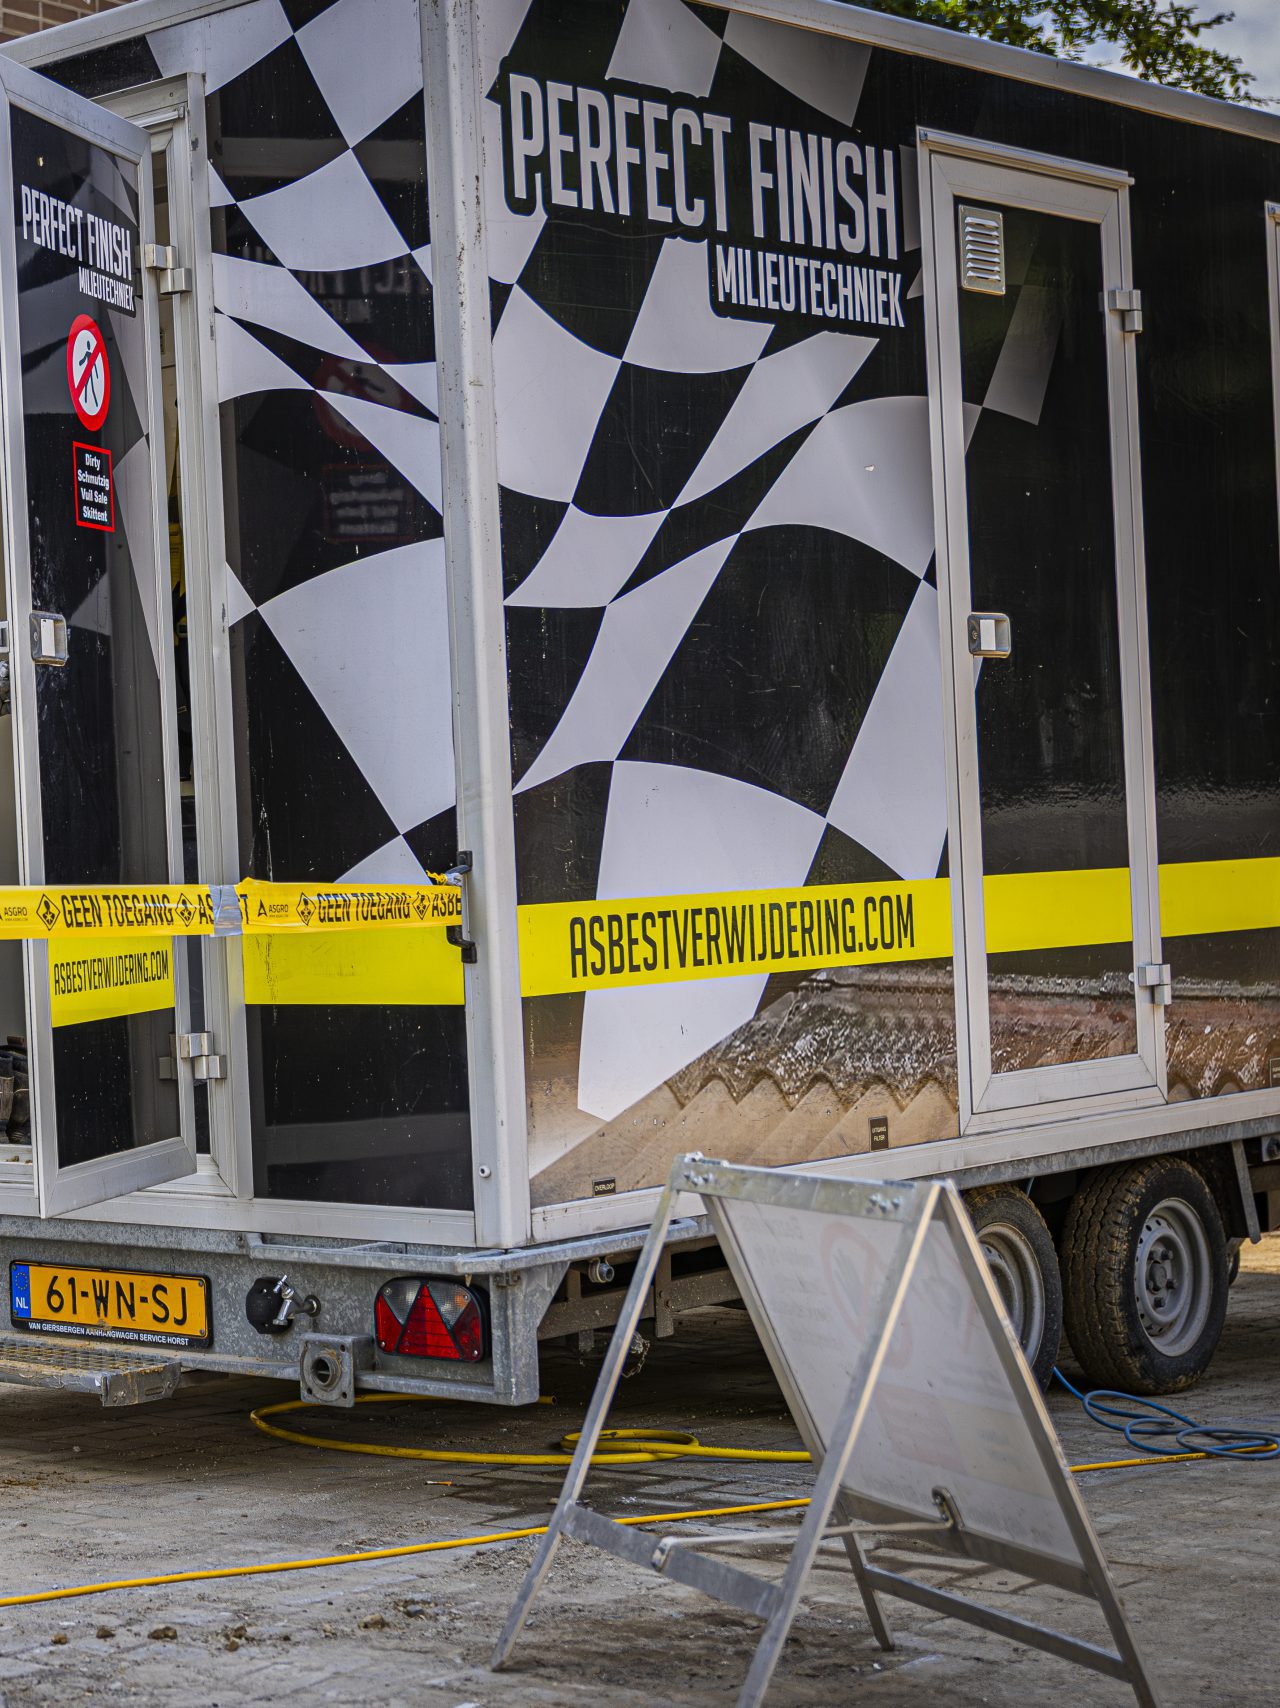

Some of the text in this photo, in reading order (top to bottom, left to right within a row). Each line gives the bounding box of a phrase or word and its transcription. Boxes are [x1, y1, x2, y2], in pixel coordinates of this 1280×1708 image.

[509, 73, 898, 261] PERFECT FINISH
[21, 184, 132, 281] PERFECT FINISH
[78, 266, 134, 312] MILIEUTECHNIEK
[716, 244, 905, 328] MILIEUTECHNIEK
[85, 453, 100, 471] Dirty
[77, 469, 110, 490] Schmutzig
[80, 487, 108, 504] Vuil Sale
[83, 505, 108, 522] Skittent
[4, 906, 28, 916] ASGRO
[61, 894, 102, 928] GEEN
[102, 893, 174, 927] TOEGANG
[269, 904, 288, 913] ASGRO
[317, 893, 350, 923] GEEN
[351, 892, 411, 921] TOEGANG
[570, 893, 915, 979] ASBESTVERWIJDERING.COM
[53, 949, 169, 996] ASBESTVERWIJDERING.COM
[15, 1275, 188, 1326] NL 61-WN-SJ
[28, 1321, 189, 1346] VAN GIERSBERGEN AANHANGWAGEN SERVICE HORST
